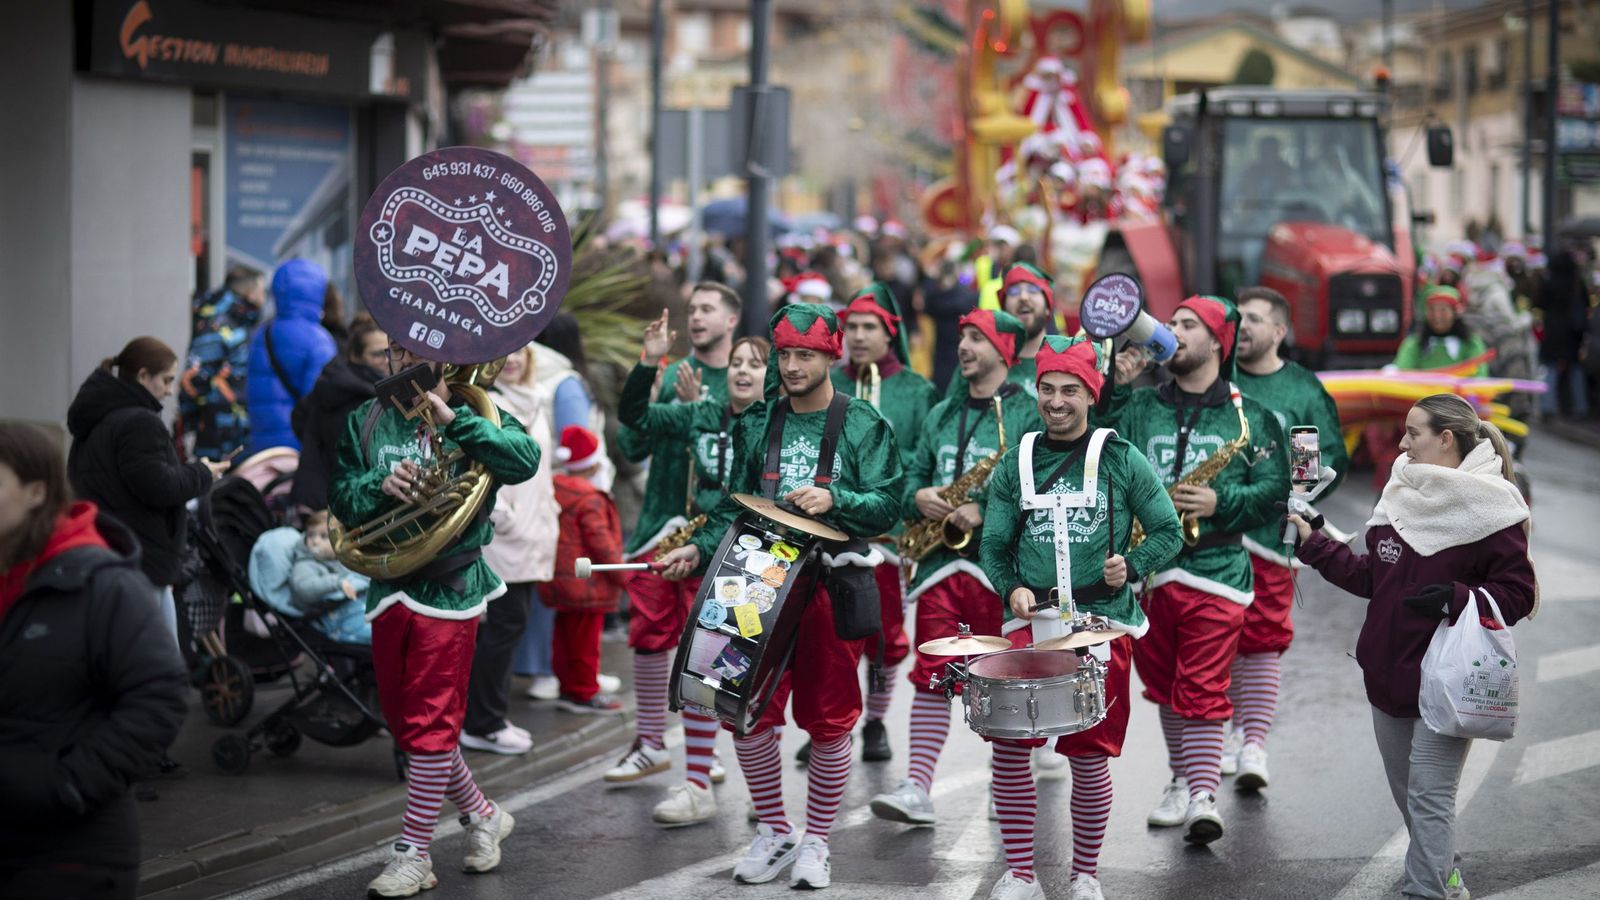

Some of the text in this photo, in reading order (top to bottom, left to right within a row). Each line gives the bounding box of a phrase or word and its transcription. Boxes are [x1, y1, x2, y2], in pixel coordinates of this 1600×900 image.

[423, 162, 449, 181] 645
[451, 162, 471, 176] 931
[473, 162, 496, 180] 437
[500, 172, 524, 194] 660
[520, 188, 544, 213] 886
[537, 209, 557, 233] 016
[451, 227, 484, 255] LA
[402, 224, 509, 300] PEPA
[389, 288, 483, 336] CHARANGA
[1094, 298, 1127, 317] PEPA
[791, 455, 807, 465] LA
[1161, 448, 1209, 464] PPA
[1033, 535, 1090, 543] CHANGA
